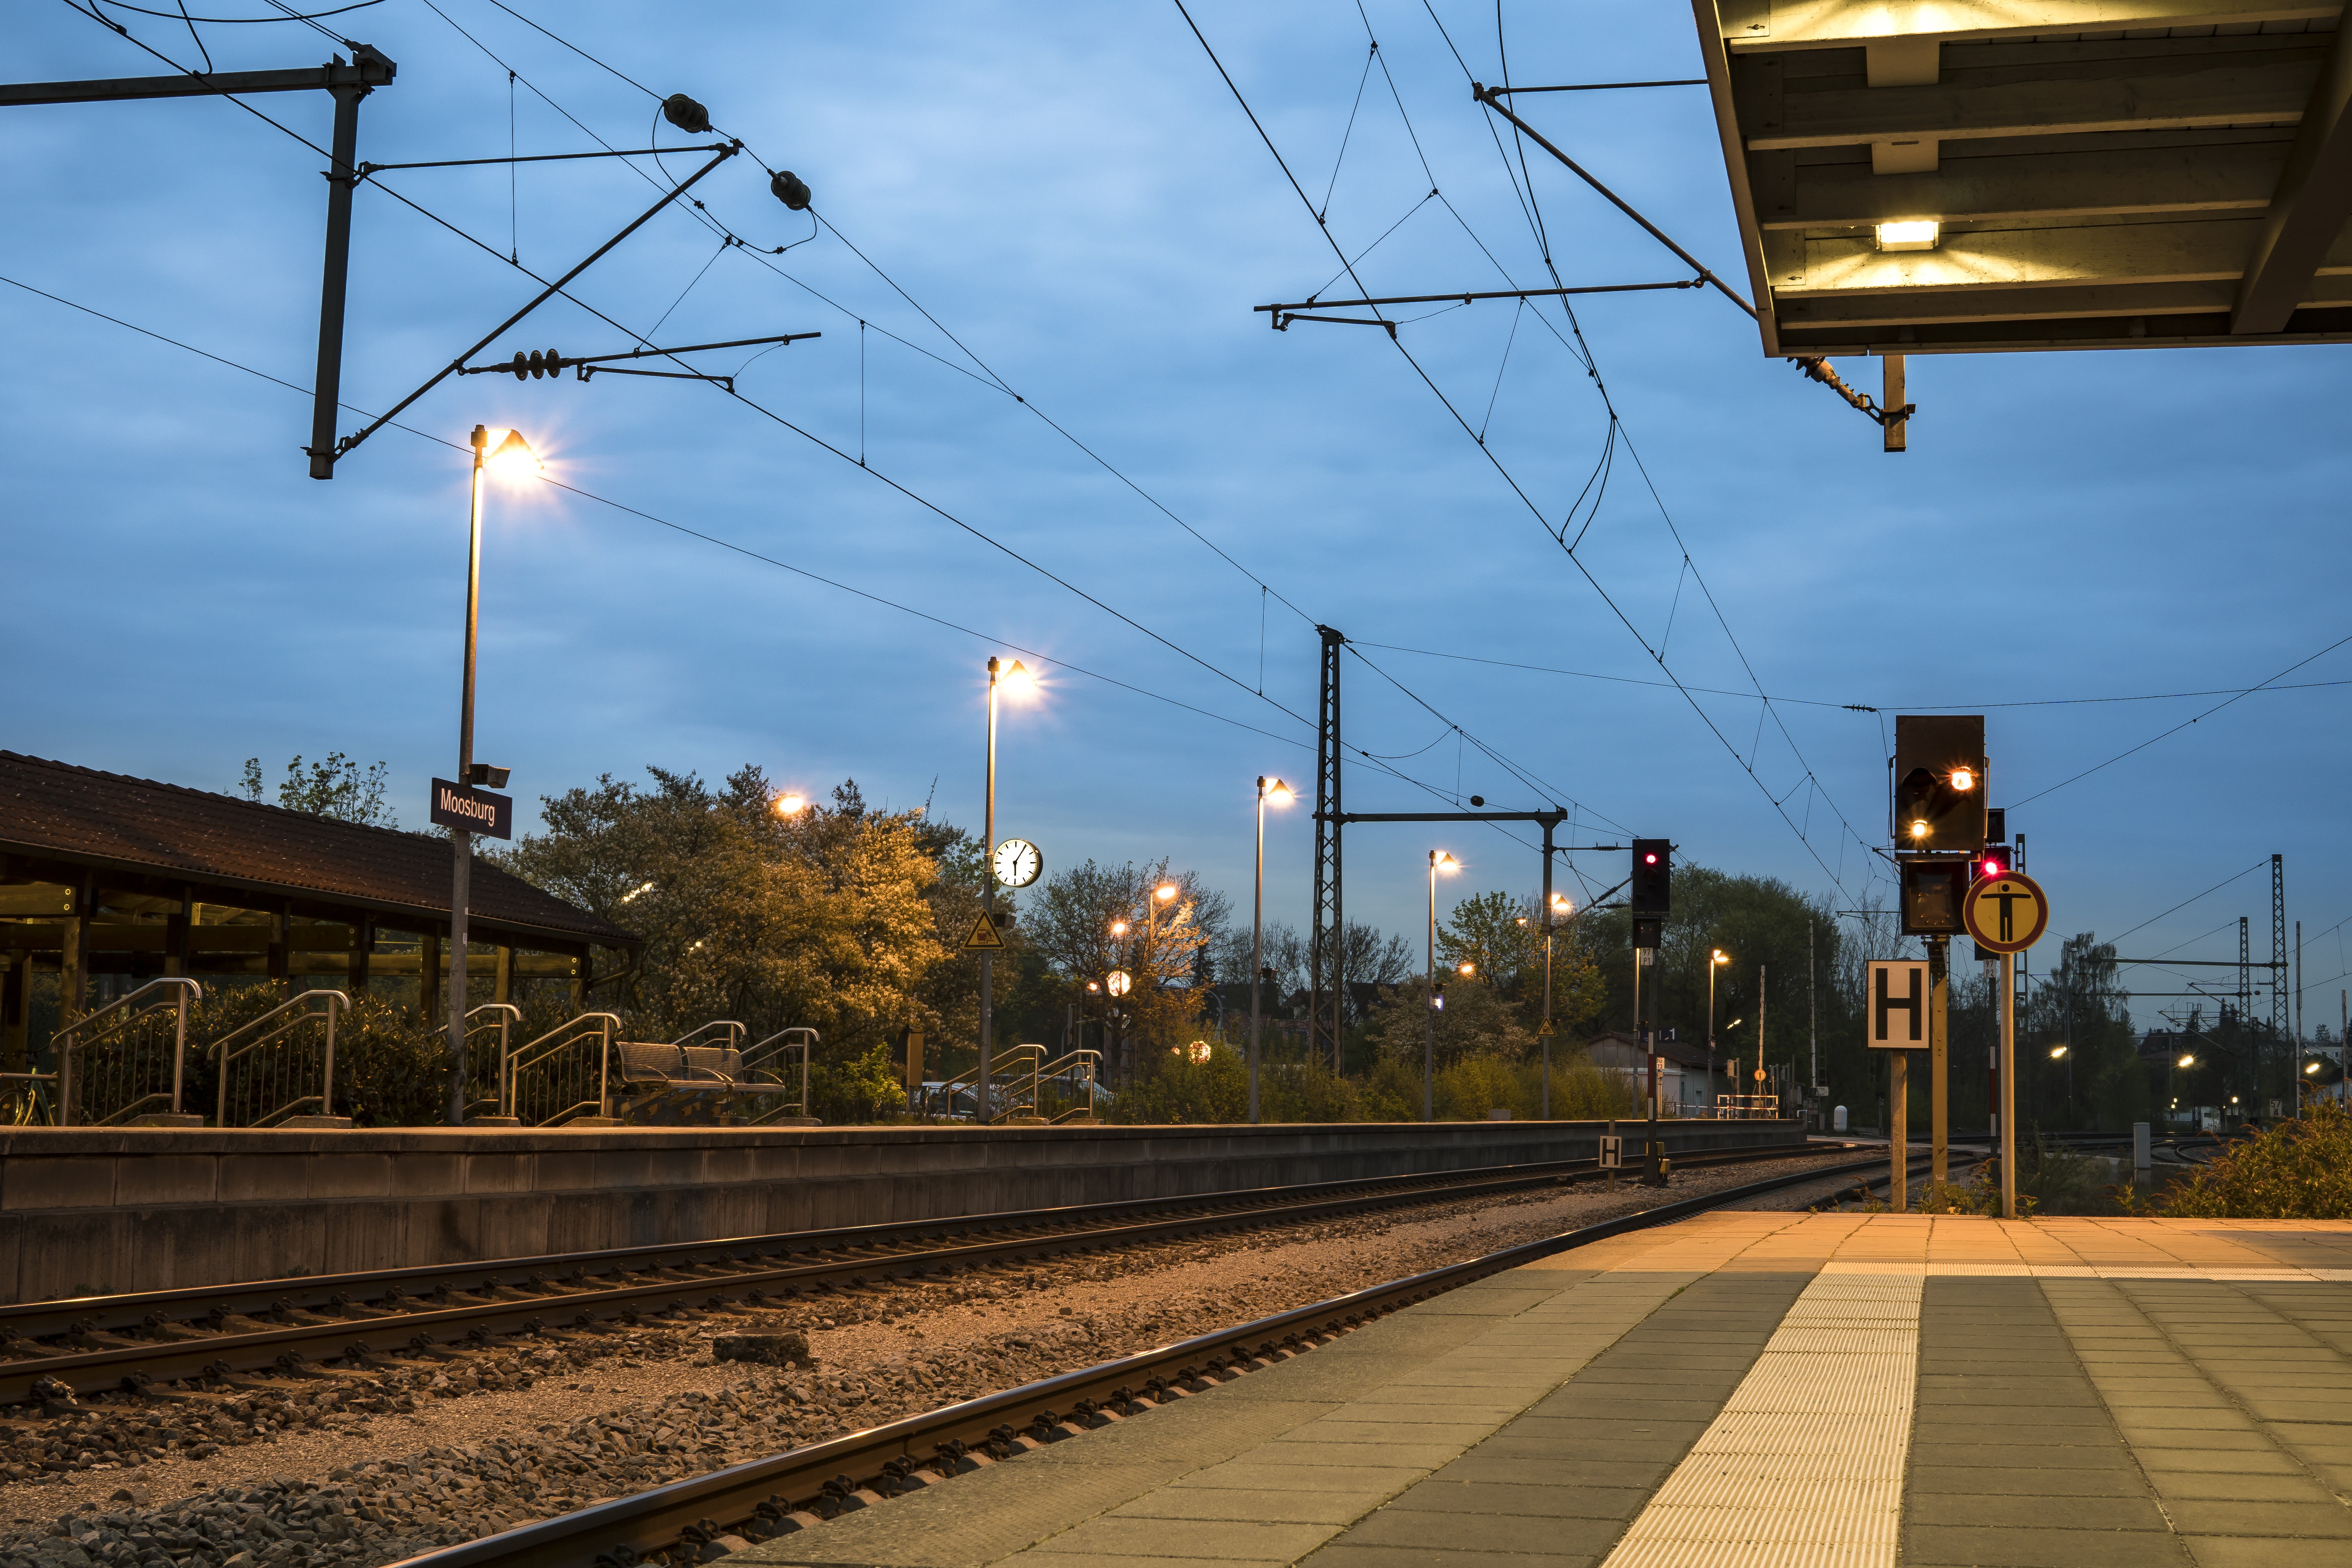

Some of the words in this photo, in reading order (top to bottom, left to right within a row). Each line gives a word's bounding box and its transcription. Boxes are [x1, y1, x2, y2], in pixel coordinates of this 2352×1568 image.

[441, 788, 495, 827] Moosburg
[1986, 969, 1994, 977] P2
[1430, 996, 1441, 1009] Moosb
[1875, 968, 1922, 1041] H
[1670, 1028, 1675, 1040] 1
[2270, 1099, 2281, 1107] 57
[2274, 1108, 2279, 1116] 4
[1602, 1138, 1619, 1165] H
